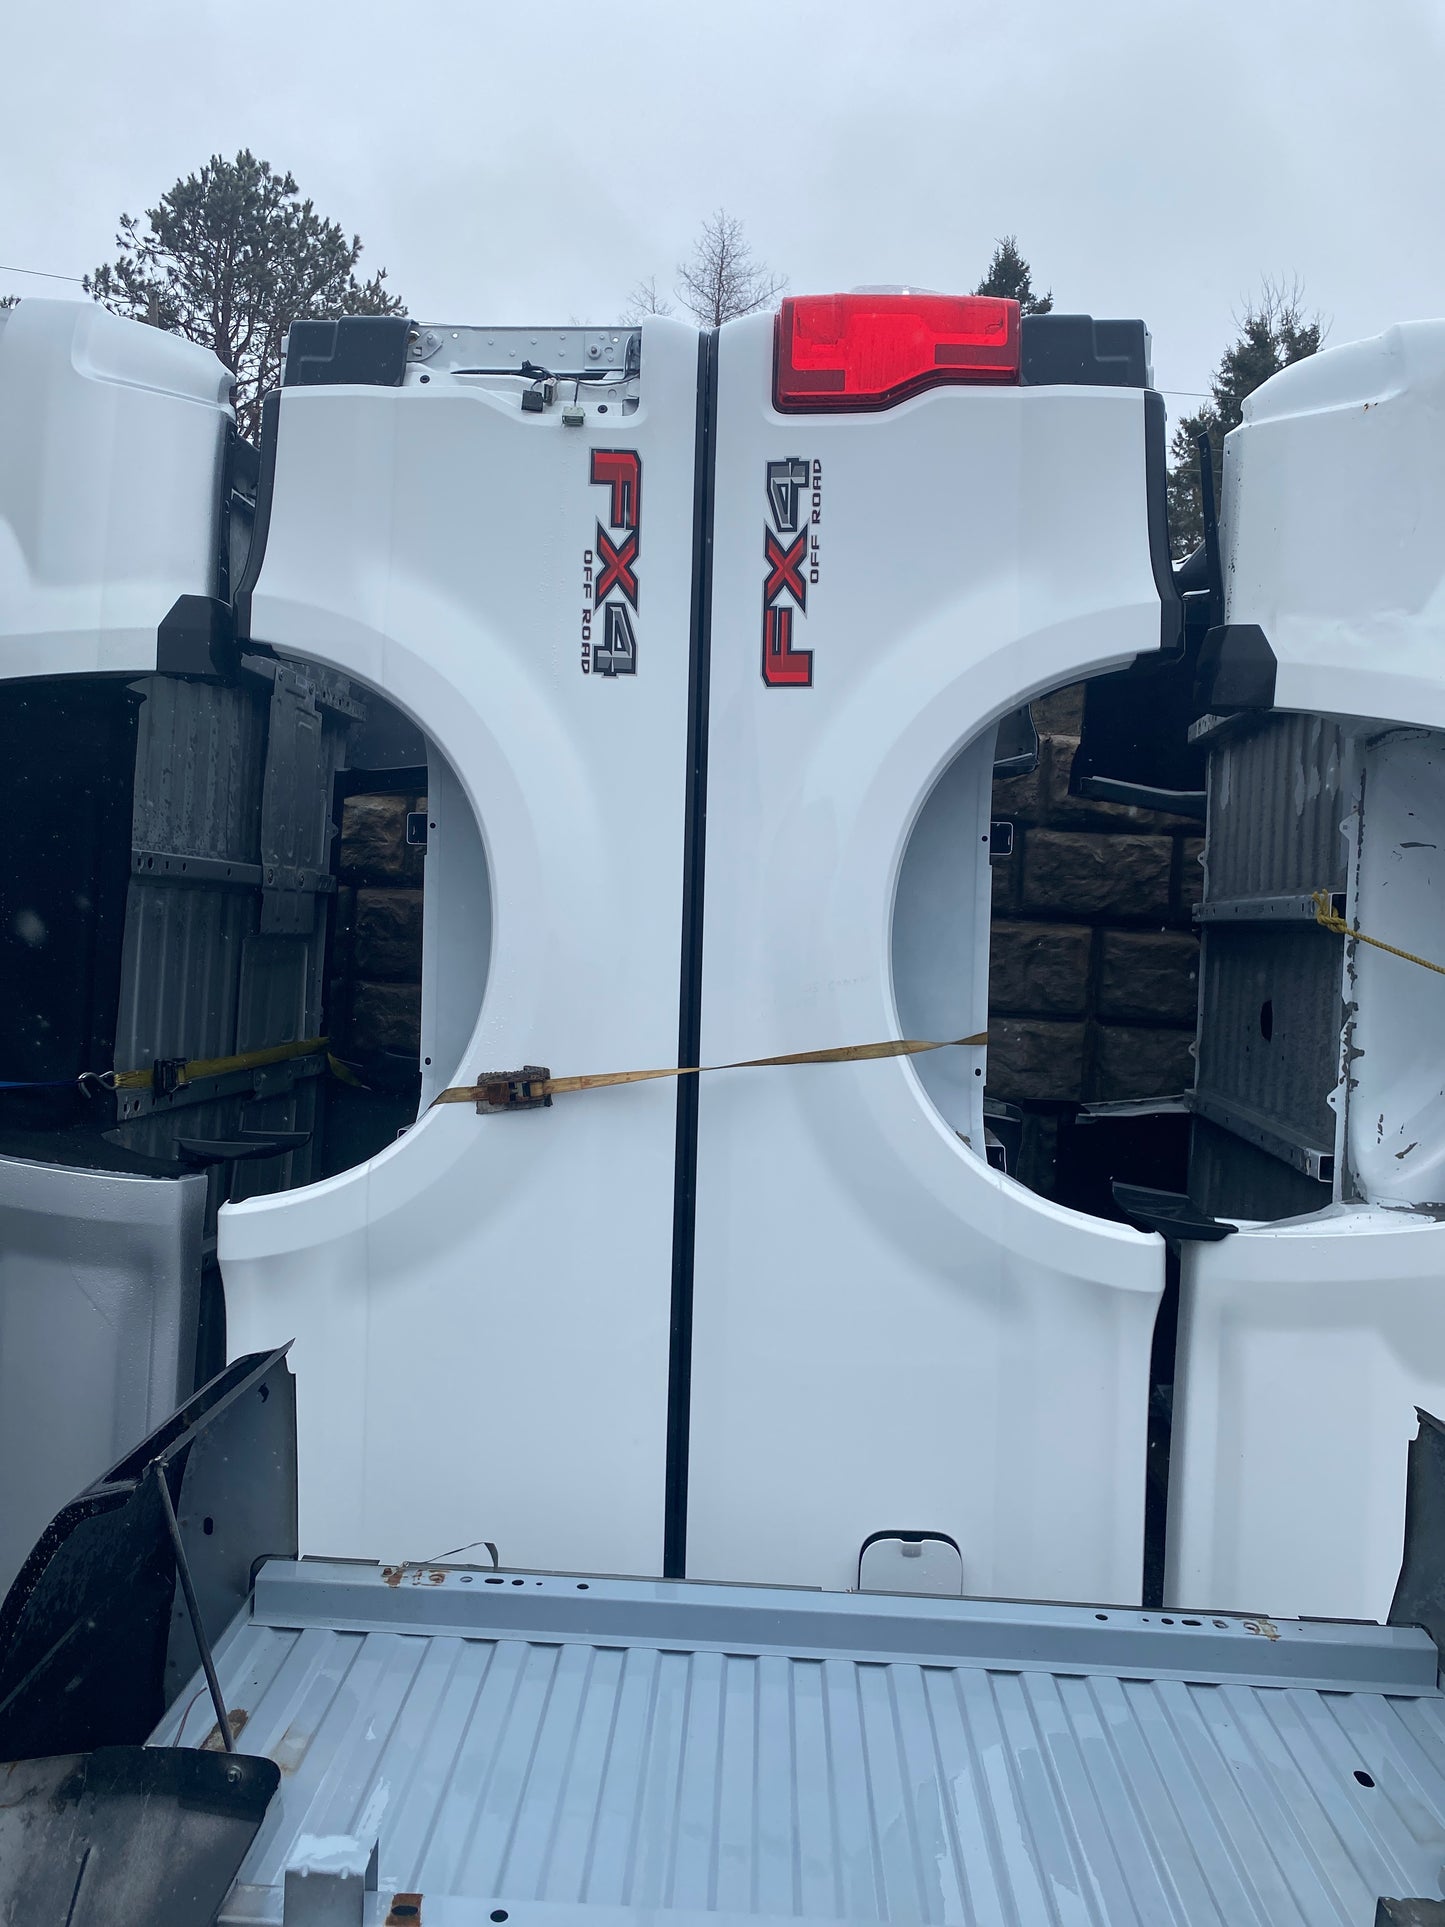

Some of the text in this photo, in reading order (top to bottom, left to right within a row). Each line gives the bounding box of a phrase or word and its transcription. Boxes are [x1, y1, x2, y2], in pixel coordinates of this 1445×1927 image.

[588, 446, 643, 678] FX4
[760, 456, 815, 689] FX4
[810, 458, 822, 584] OFF ROAD
[581, 549, 593, 675] OFF ROAD
